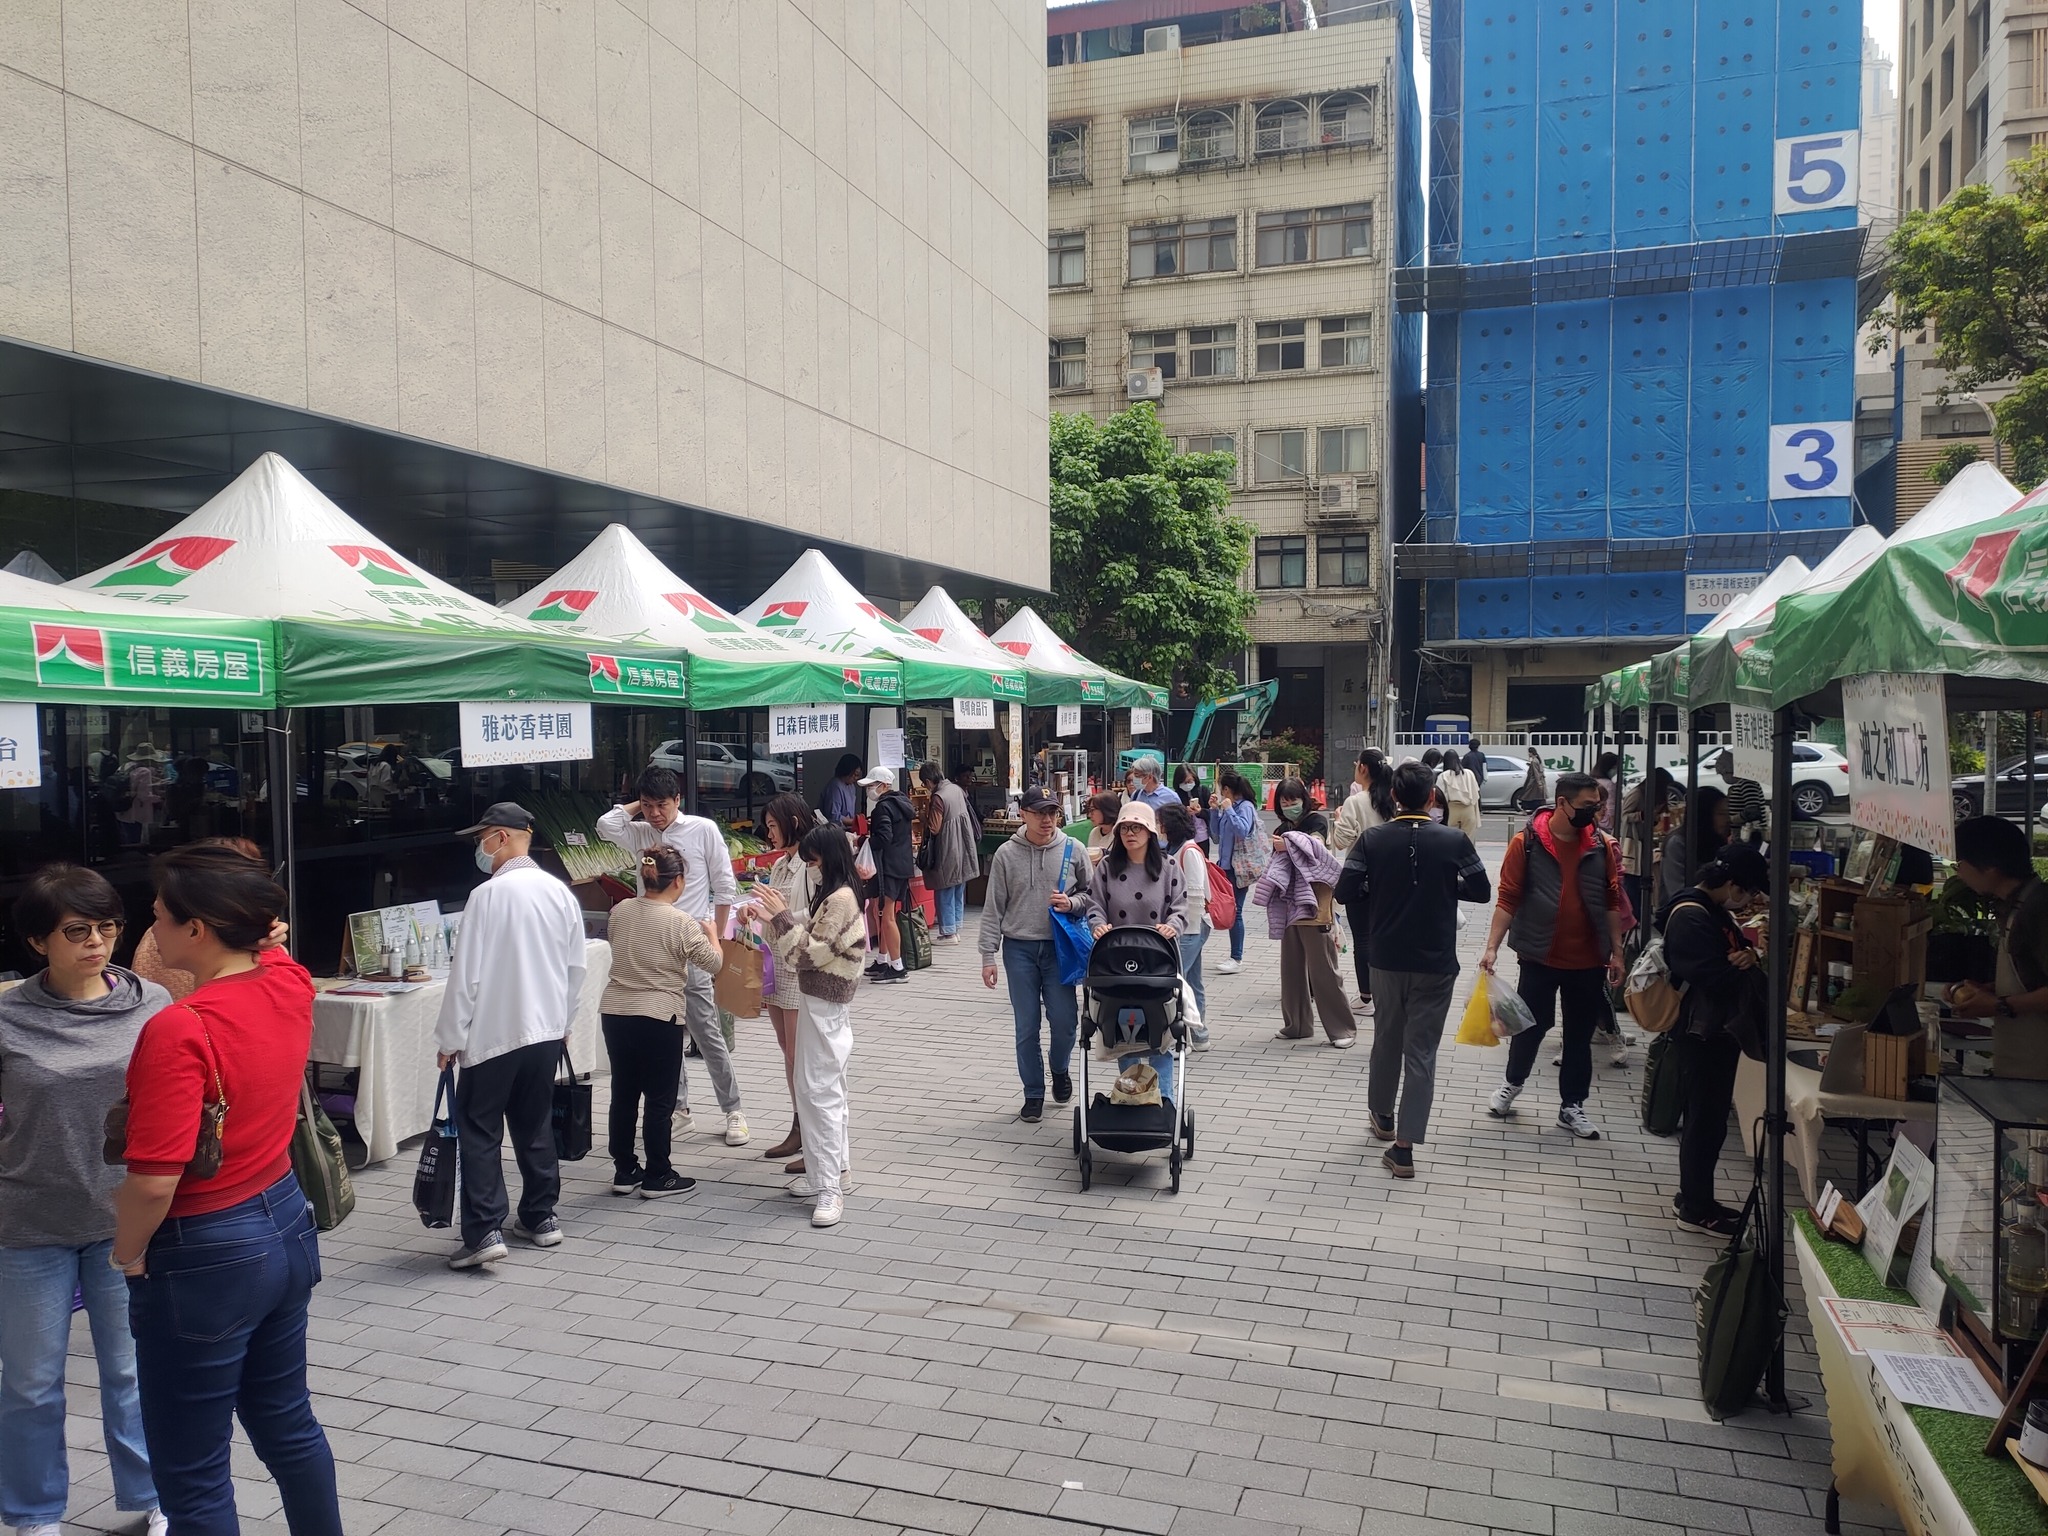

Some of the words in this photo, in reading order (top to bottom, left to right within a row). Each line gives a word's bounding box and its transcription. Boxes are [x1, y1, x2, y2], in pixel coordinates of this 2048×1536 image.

[1786, 138, 1846, 205] 5
[1785, 428, 1838, 492] 3
[126, 643, 250, 681] 信義房屋
[626, 666, 680, 690] 信義房屋
[864, 675, 898, 692] 信義房屋
[481, 712, 573, 742] 雅芯香草園
[776, 713, 840, 737] 日森有機農場
[1041, 787, 1051, 800] P
